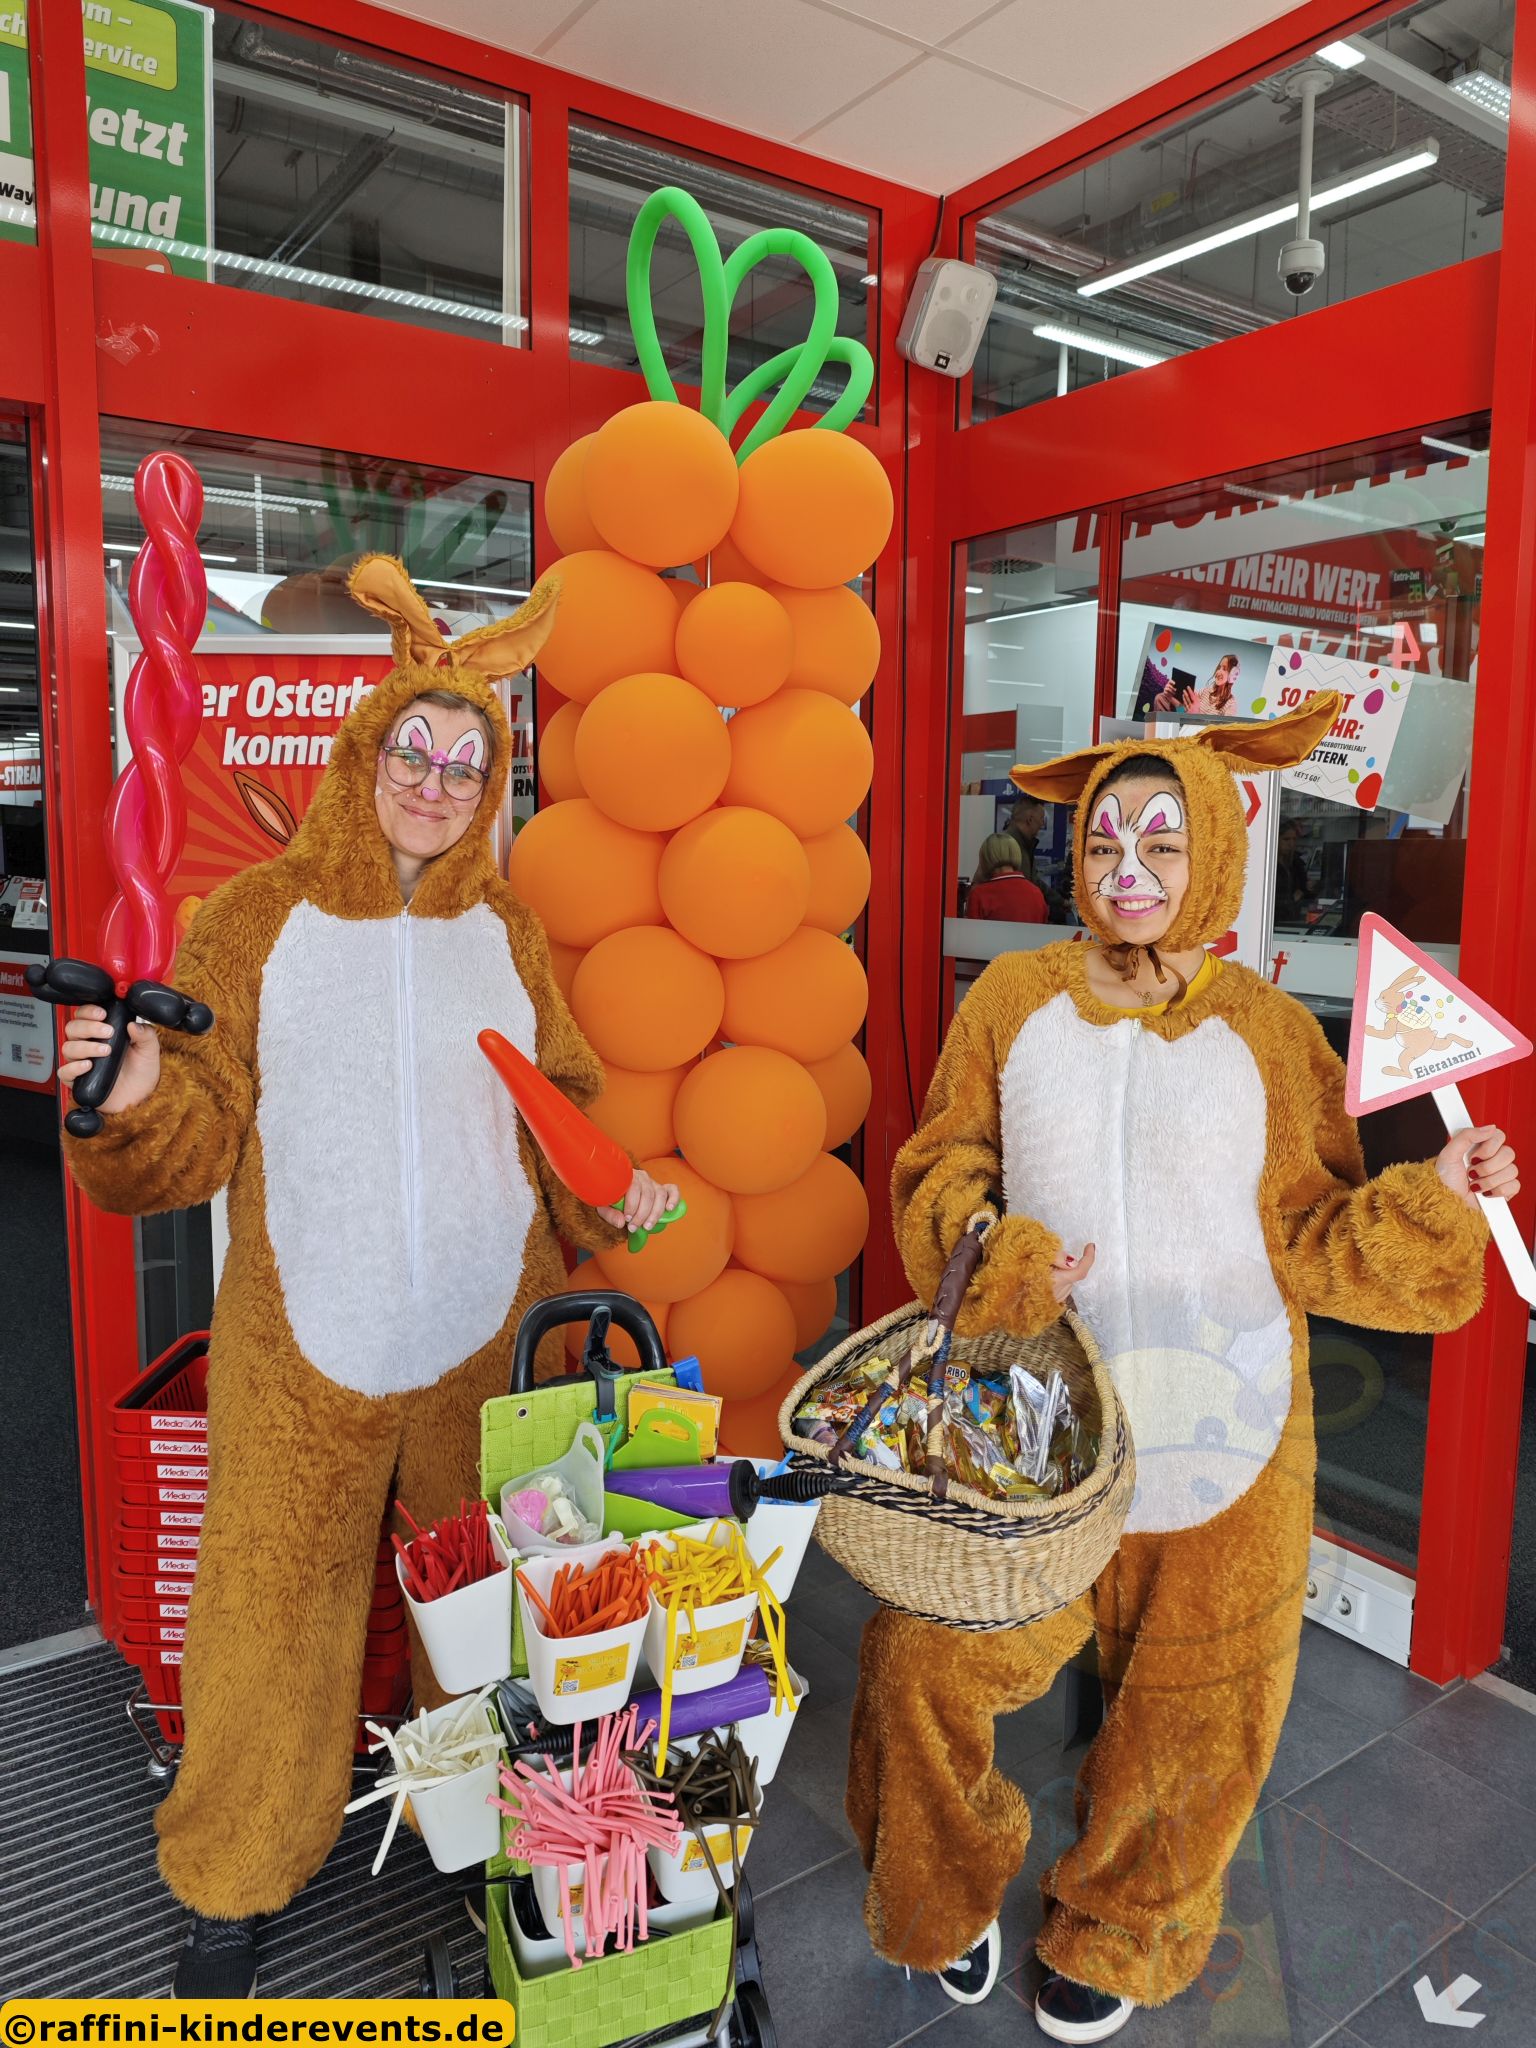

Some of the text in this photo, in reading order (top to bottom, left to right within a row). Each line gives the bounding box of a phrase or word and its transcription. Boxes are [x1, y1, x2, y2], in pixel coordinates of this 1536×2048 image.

[86, 96, 188, 167] etzt
[1231, 553, 1309, 599] MEHR
[1313, 562, 1382, 611] WERT.
[1228, 593, 1251, 609] JETZT
[1250, 597, 1299, 615] MITMACHEN
[1299, 606, 1316, 619] UND
[1316, 609, 1349, 624] VORTEILE
[1278, 687, 1301, 708] SO
[1294, 770, 1320, 783] LET'S GO!
